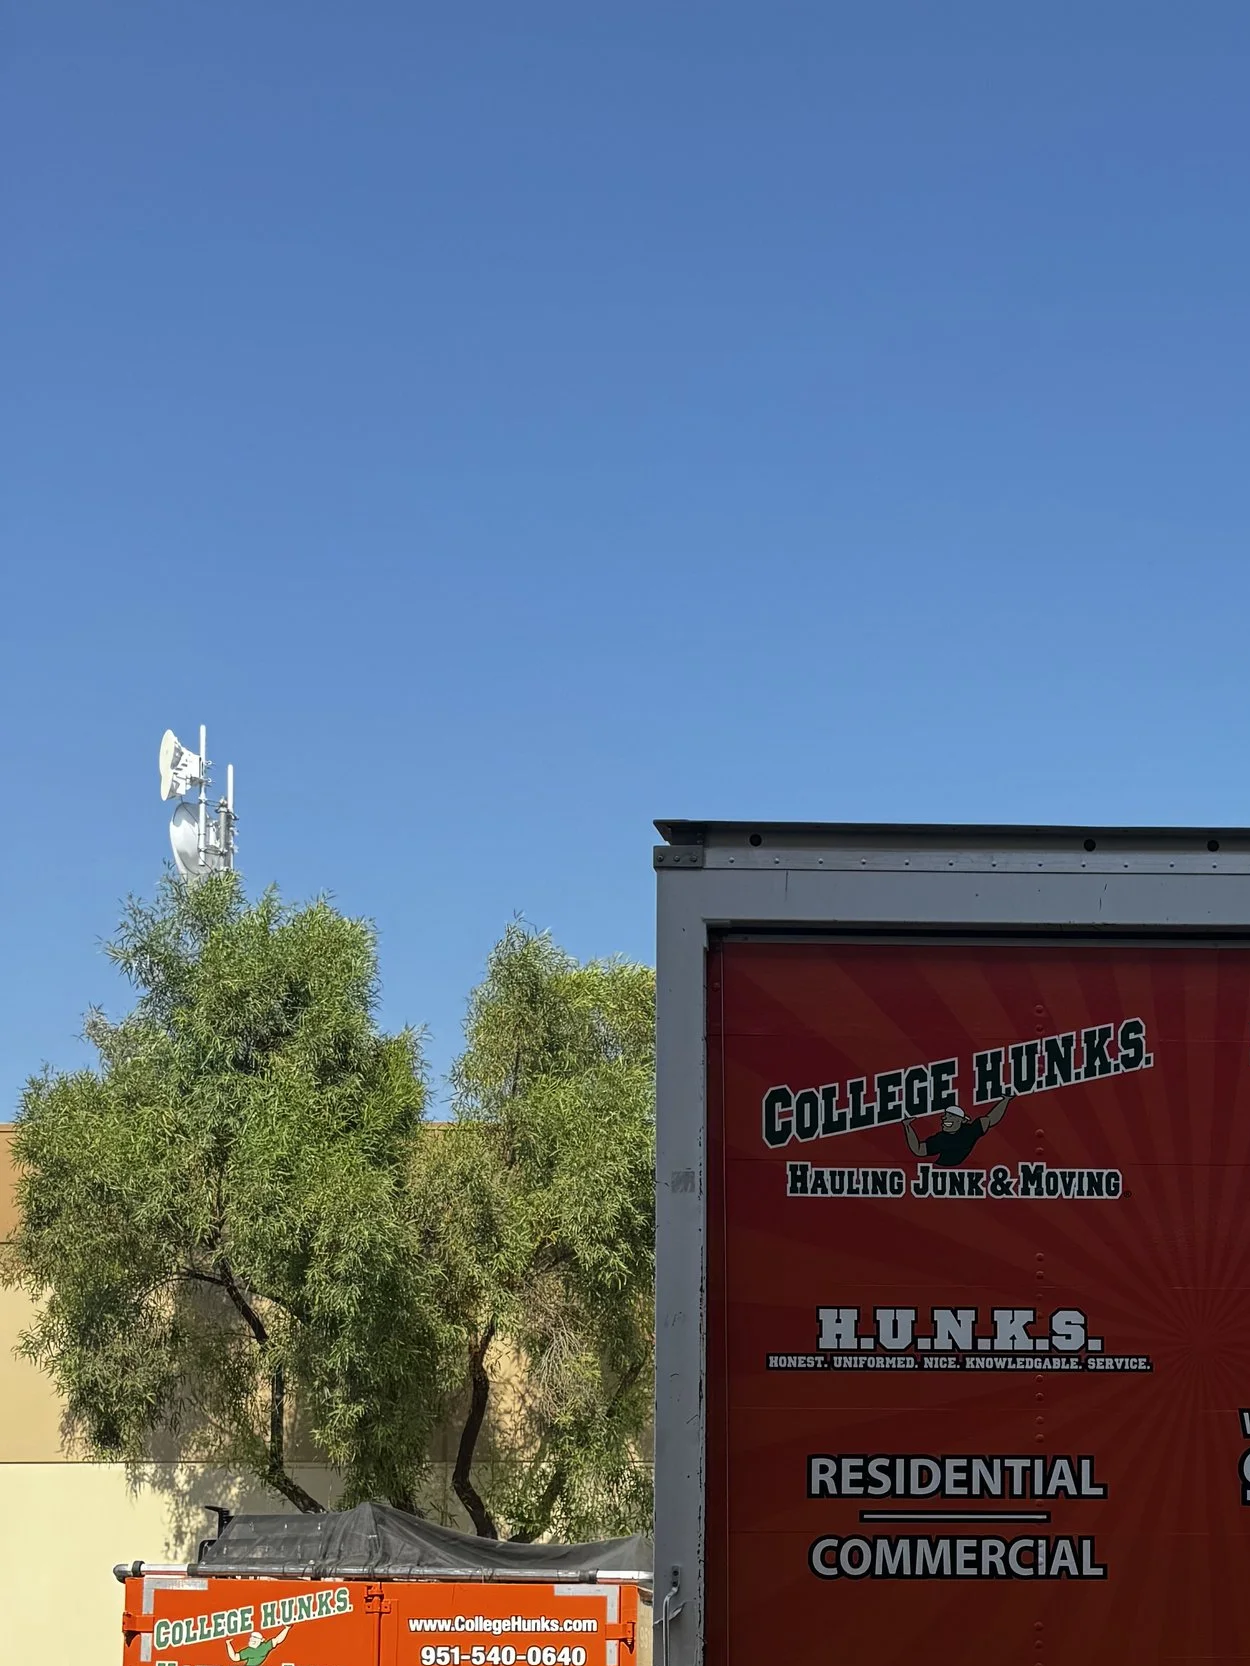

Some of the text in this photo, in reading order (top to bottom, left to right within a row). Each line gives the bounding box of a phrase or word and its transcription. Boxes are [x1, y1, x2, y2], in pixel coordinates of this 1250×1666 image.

[762, 1017, 1154, 1149] COLLEGE H.U.N.K.S.
[786, 1161, 905, 1197] HAULING
[911, 1163, 987, 1199] JUNK
[989, 1165, 1018, 1198] &
[818, 1308, 1103, 1350] H.U.N.K.S.
[768, 1355, 1151, 1370] HONEST. UNIFORMED. NICE. KNOWLEDGABLE. SERVICE.
[811, 1457, 1104, 1496] RESIDENTIAL
[812, 1538, 1104, 1576] COMMERCIAL
[154, 1587, 353, 1650] COLLEGE H.U.N.K.S.
[409, 1616, 598, 1635] www.CollegeHunks.com
[421, 1646, 586, 1666] 951-540-0640
